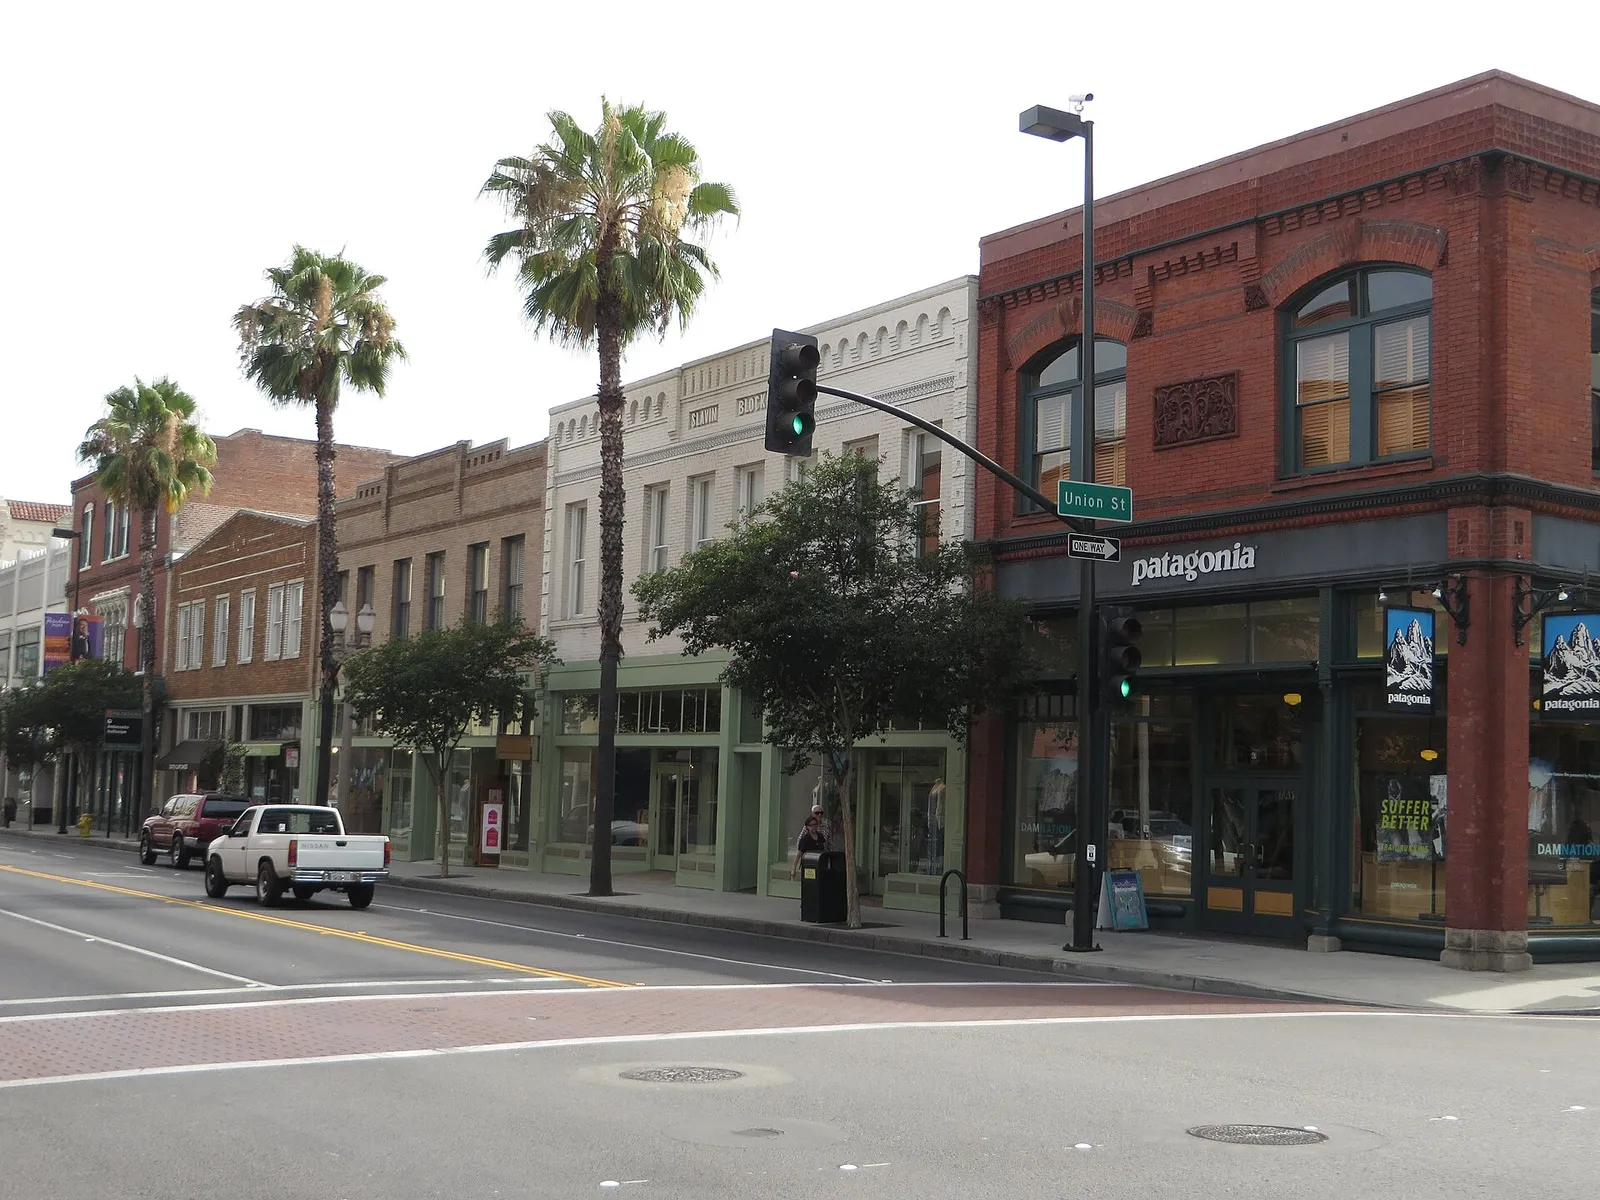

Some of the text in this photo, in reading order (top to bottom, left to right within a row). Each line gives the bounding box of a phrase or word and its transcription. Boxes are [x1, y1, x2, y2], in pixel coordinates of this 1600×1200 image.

[691, 392, 768, 428] SLAVIN BLOCK
[1065, 491, 1126, 511] Union St
[1074, 541, 1105, 554] ONE WAY
[1131, 542, 1254, 585] patagonia
[1387, 692, 1431, 706] patagonia
[1544, 698, 1600, 712] patagonia
[1381, 799, 1431, 815] SUFFER
[1382, 814, 1430, 831] BETTER
[301, 842, 330, 850] NISSAN
[1537, 843, 1600, 857] DAMNATION
